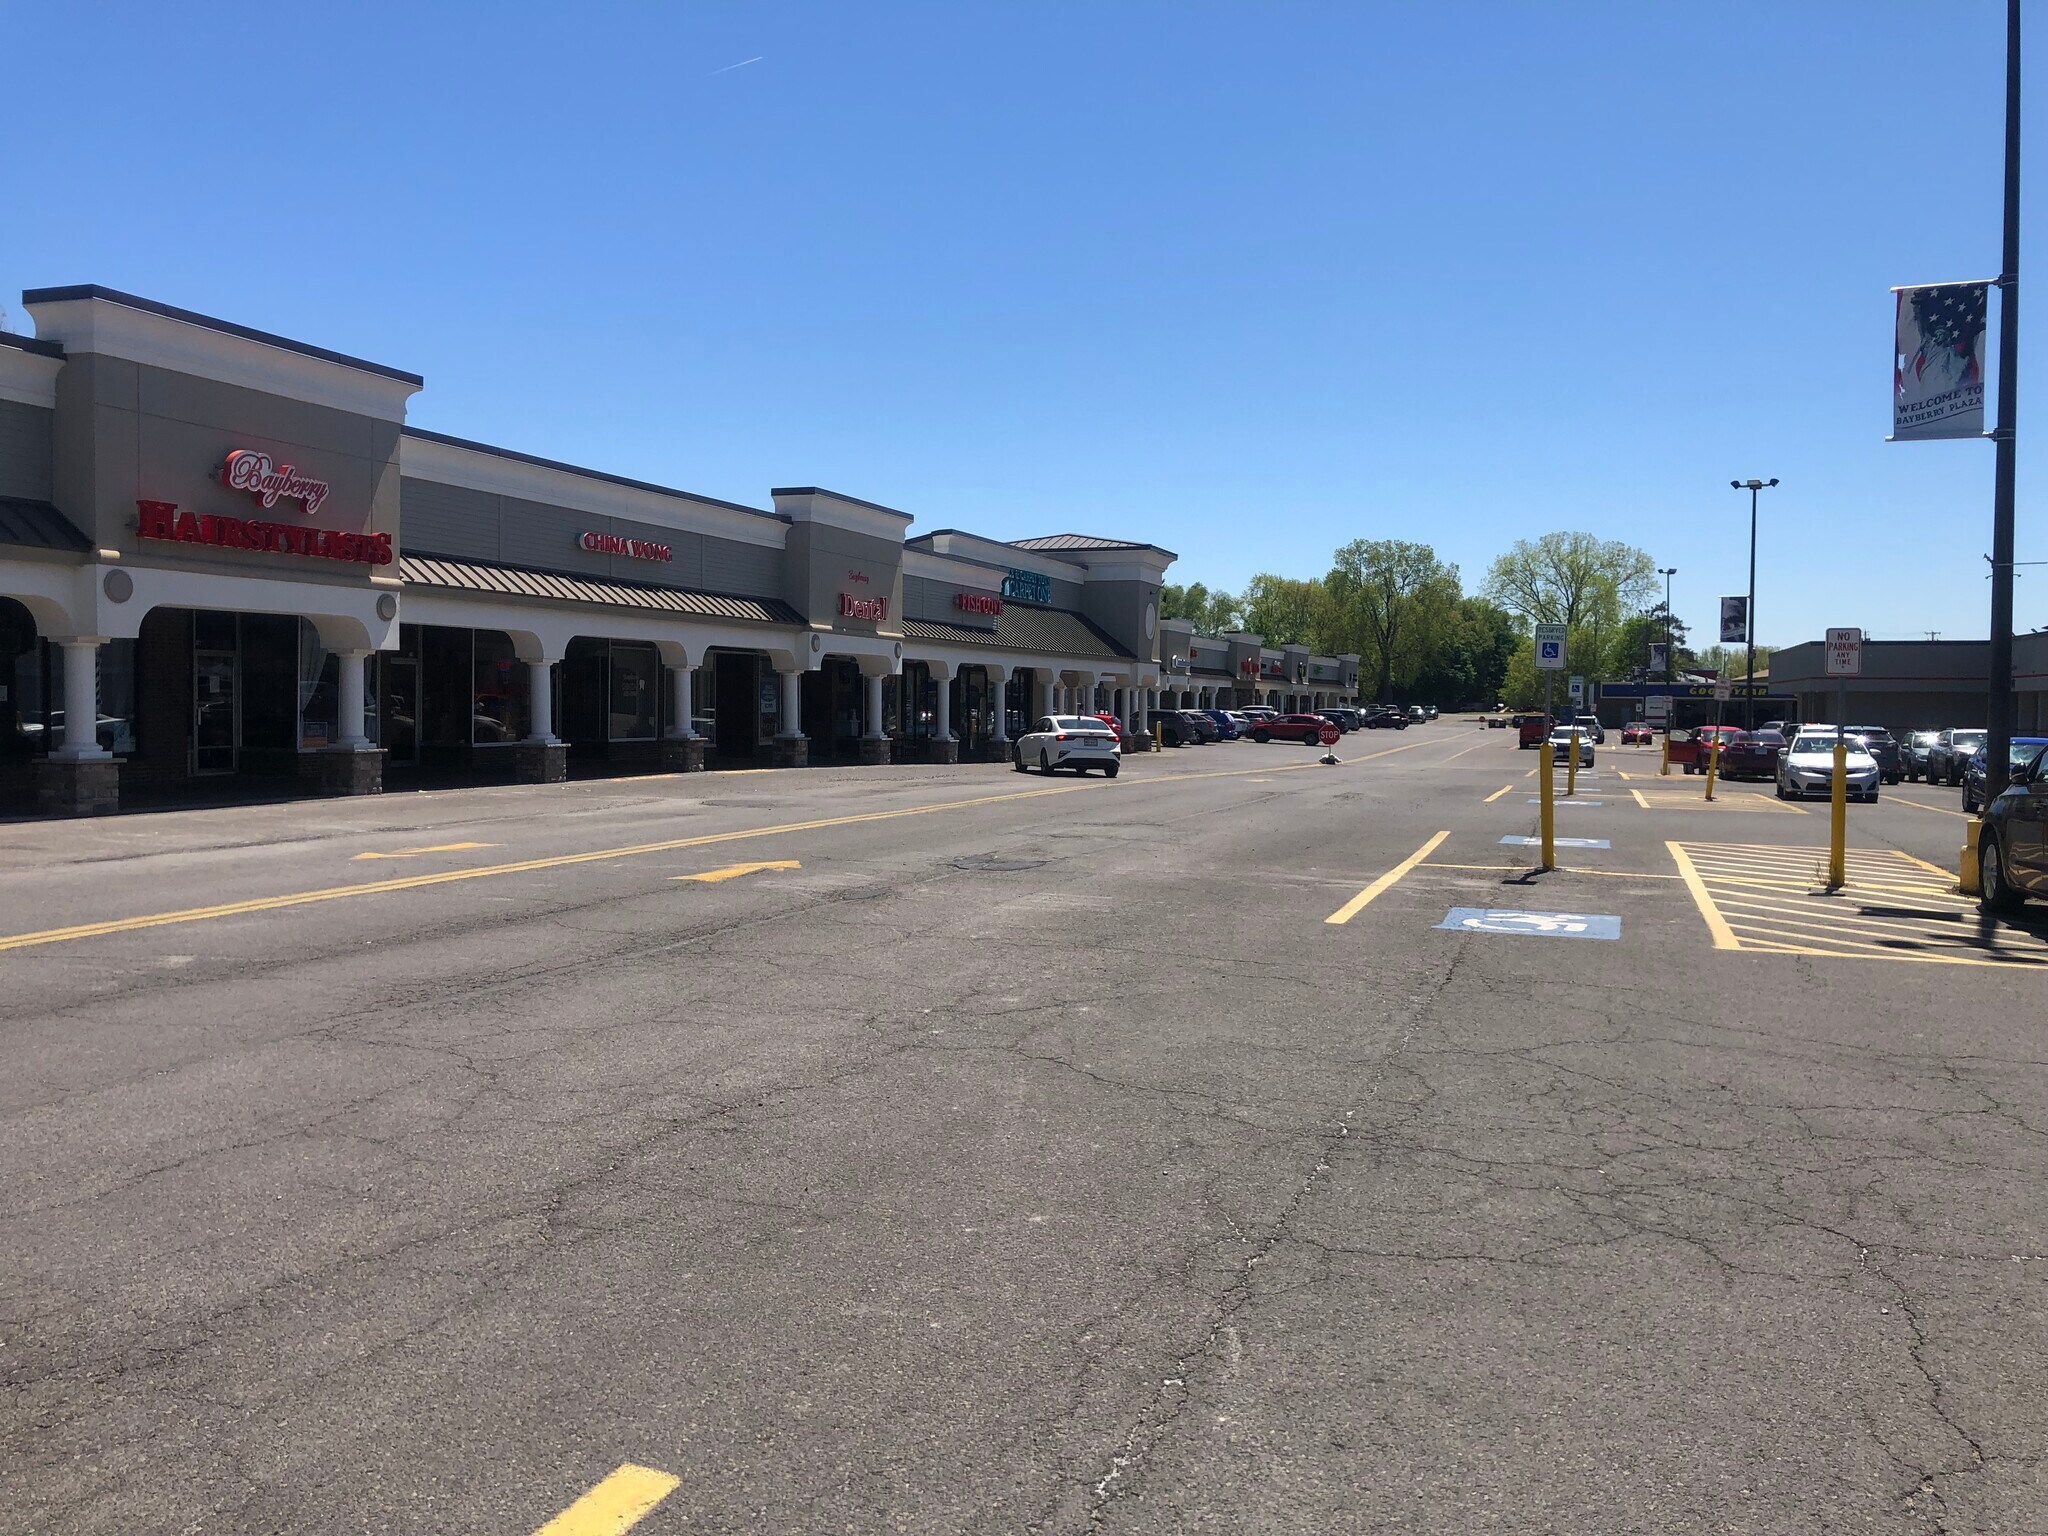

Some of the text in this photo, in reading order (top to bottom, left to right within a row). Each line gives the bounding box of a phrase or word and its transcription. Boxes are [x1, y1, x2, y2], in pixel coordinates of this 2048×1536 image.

[1896, 397, 1982, 425] BAYBERRY PLAZA
[1898, 385, 1983, 414] WELCOME TO
[230, 450, 330, 514] Bayberry
[583, 532, 673, 563] CHINA WONG
[841, 593, 887, 621] Dental
[961, 593, 981, 613] FISH
[1828, 642, 1859, 651] PARKING
[1837, 631, 1851, 641] NO
[1689, 686, 1767, 696] GOOYEAR
[1320, 730, 1339, 739] STOP
